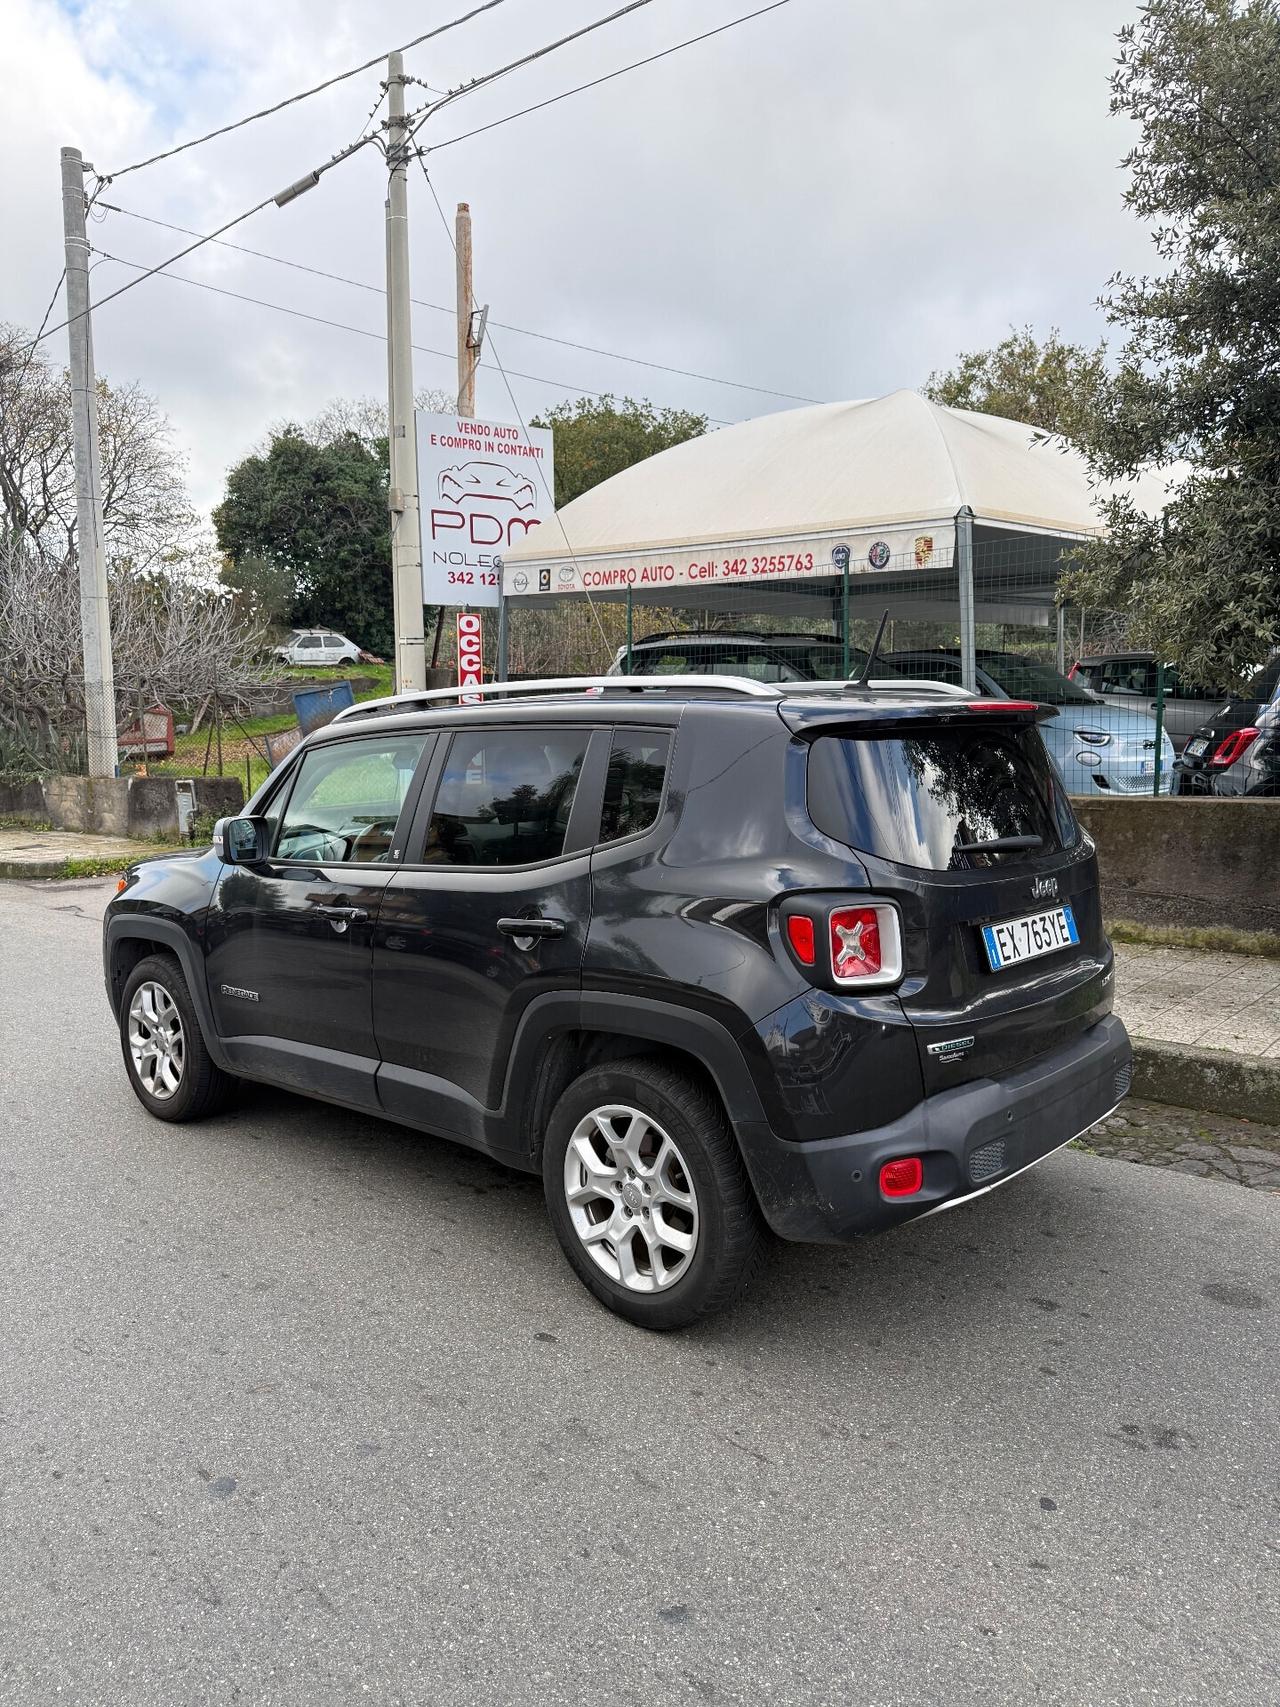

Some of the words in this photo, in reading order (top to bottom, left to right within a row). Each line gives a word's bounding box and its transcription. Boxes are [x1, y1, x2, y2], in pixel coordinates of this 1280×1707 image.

[457, 421, 490, 436] VENDO
[494, 427, 518, 440] AUTO
[431, 434, 437, 445] E
[440, 435, 481, 451] COMPRO
[484, 440, 494, 453] IN
[497, 443, 544, 458] CONTANTI
[448, 571, 475, 585] 342
[583, 567, 636, 587] COMPRO
[641, 565, 674, 583] AUTO
[688, 561, 718, 579] Cell:
[722, 558, 747, 577] 342
[751, 553, 814, 574] 3255763
[1031, 877, 1059, 899] Jeep
